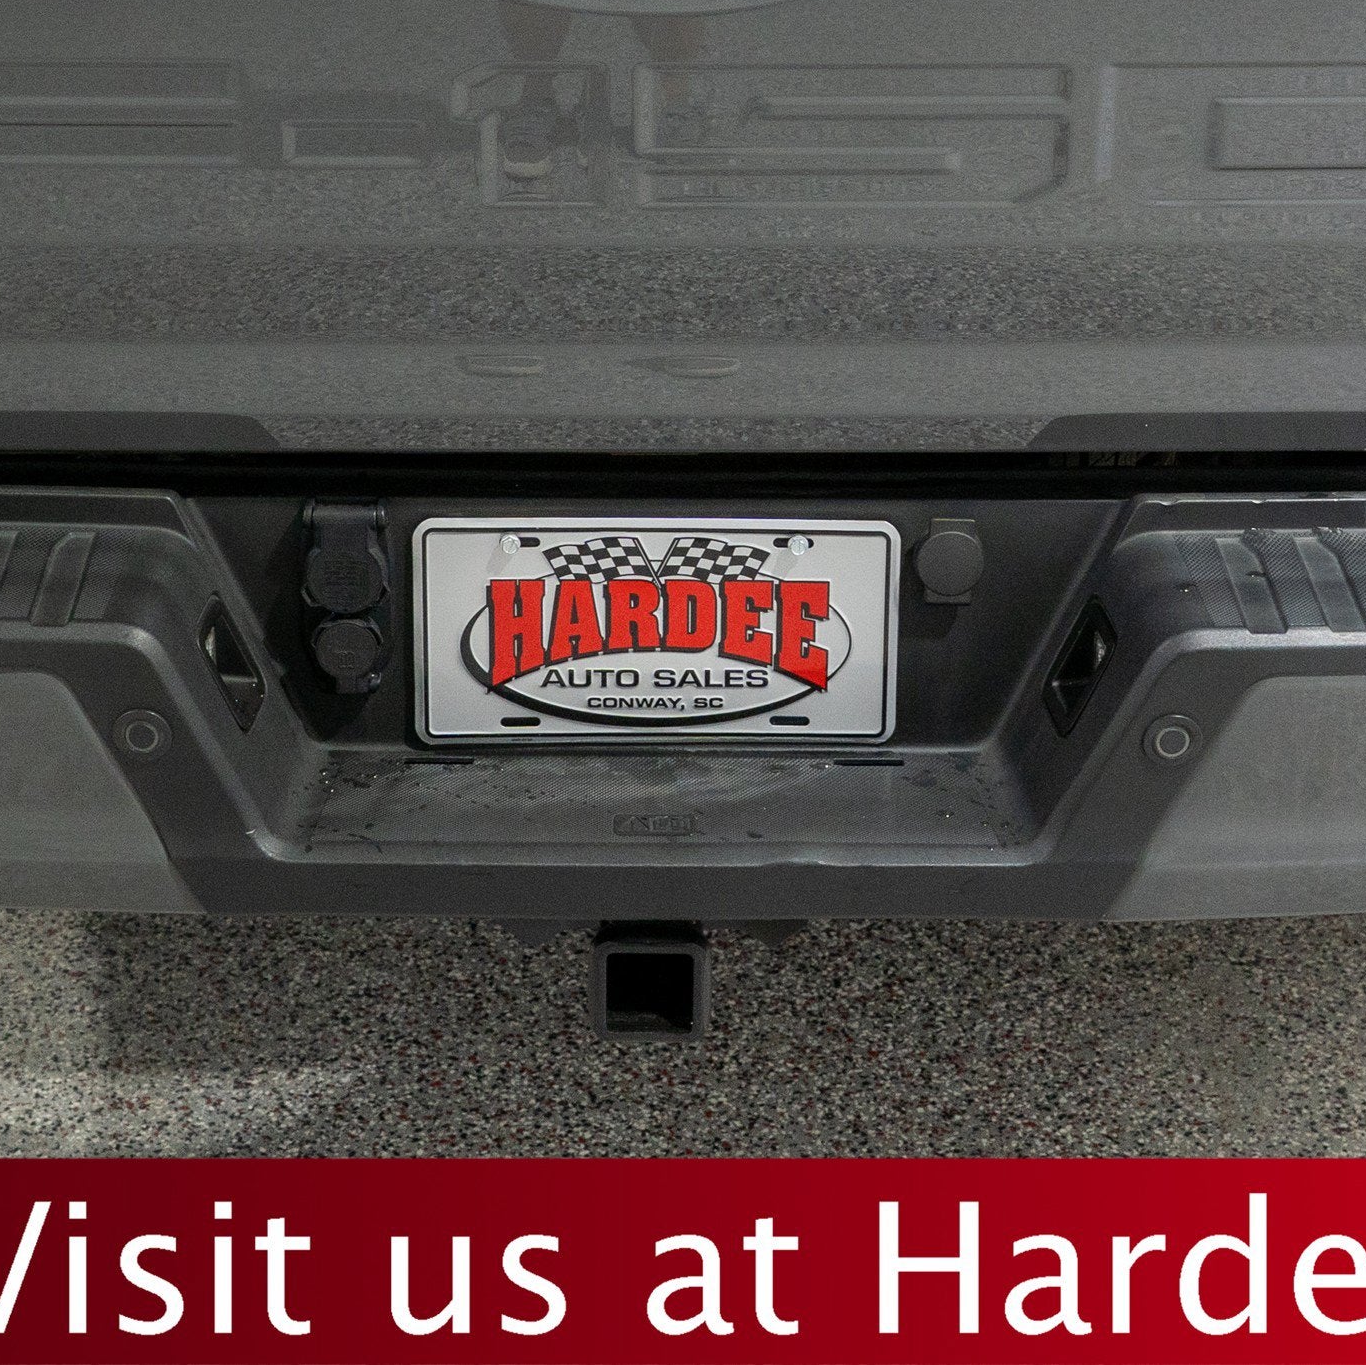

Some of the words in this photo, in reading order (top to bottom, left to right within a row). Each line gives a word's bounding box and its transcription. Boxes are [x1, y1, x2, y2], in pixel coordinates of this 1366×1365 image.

[485, 579, 831, 693] HARDEE
[540, 668, 640, 688] AUTO
[653, 668, 769, 689] SALES
[587, 697, 686, 710] CONWAY,
[693, 697, 724, 709] SC
